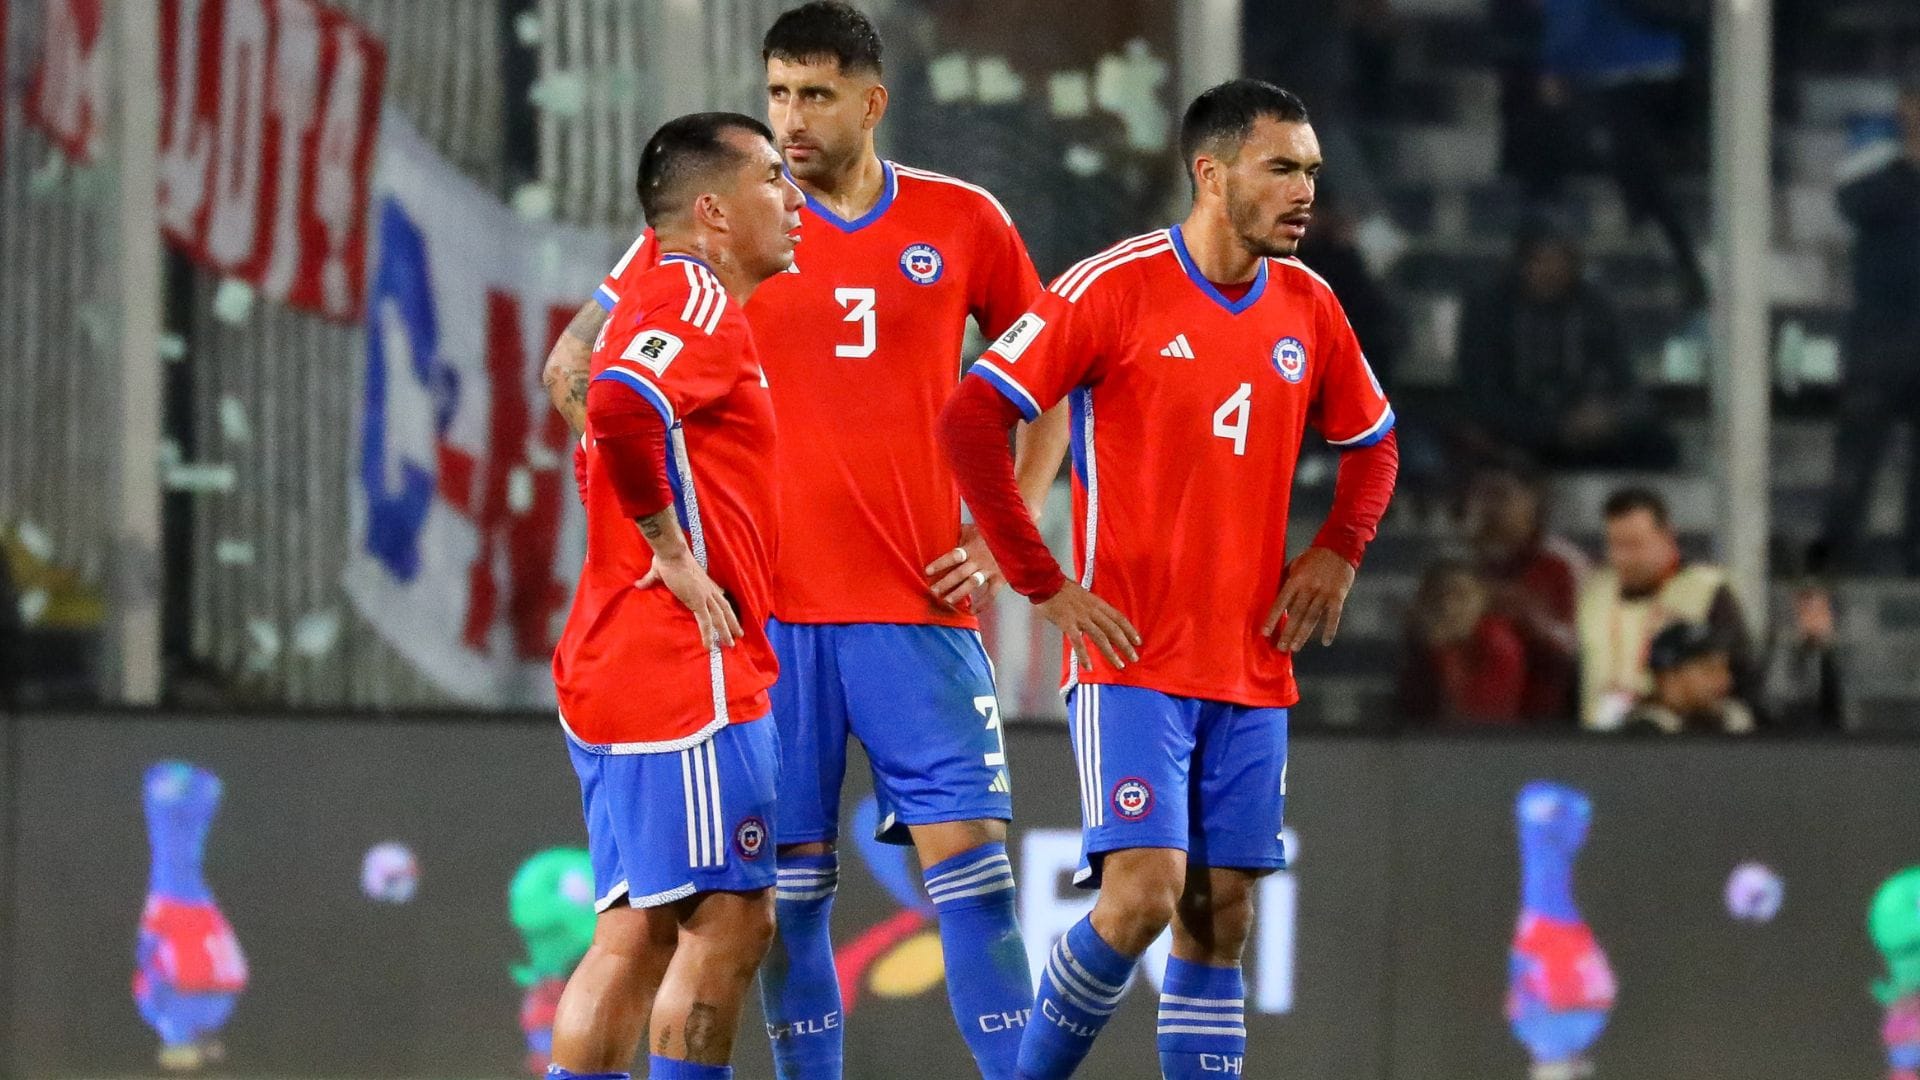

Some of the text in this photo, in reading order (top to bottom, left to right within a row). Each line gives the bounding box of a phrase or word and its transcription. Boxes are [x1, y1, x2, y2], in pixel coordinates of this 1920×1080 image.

[834, 287, 877, 358] 3
[1212, 382, 1252, 456] 4
[973, 695, 1005, 766] 3
